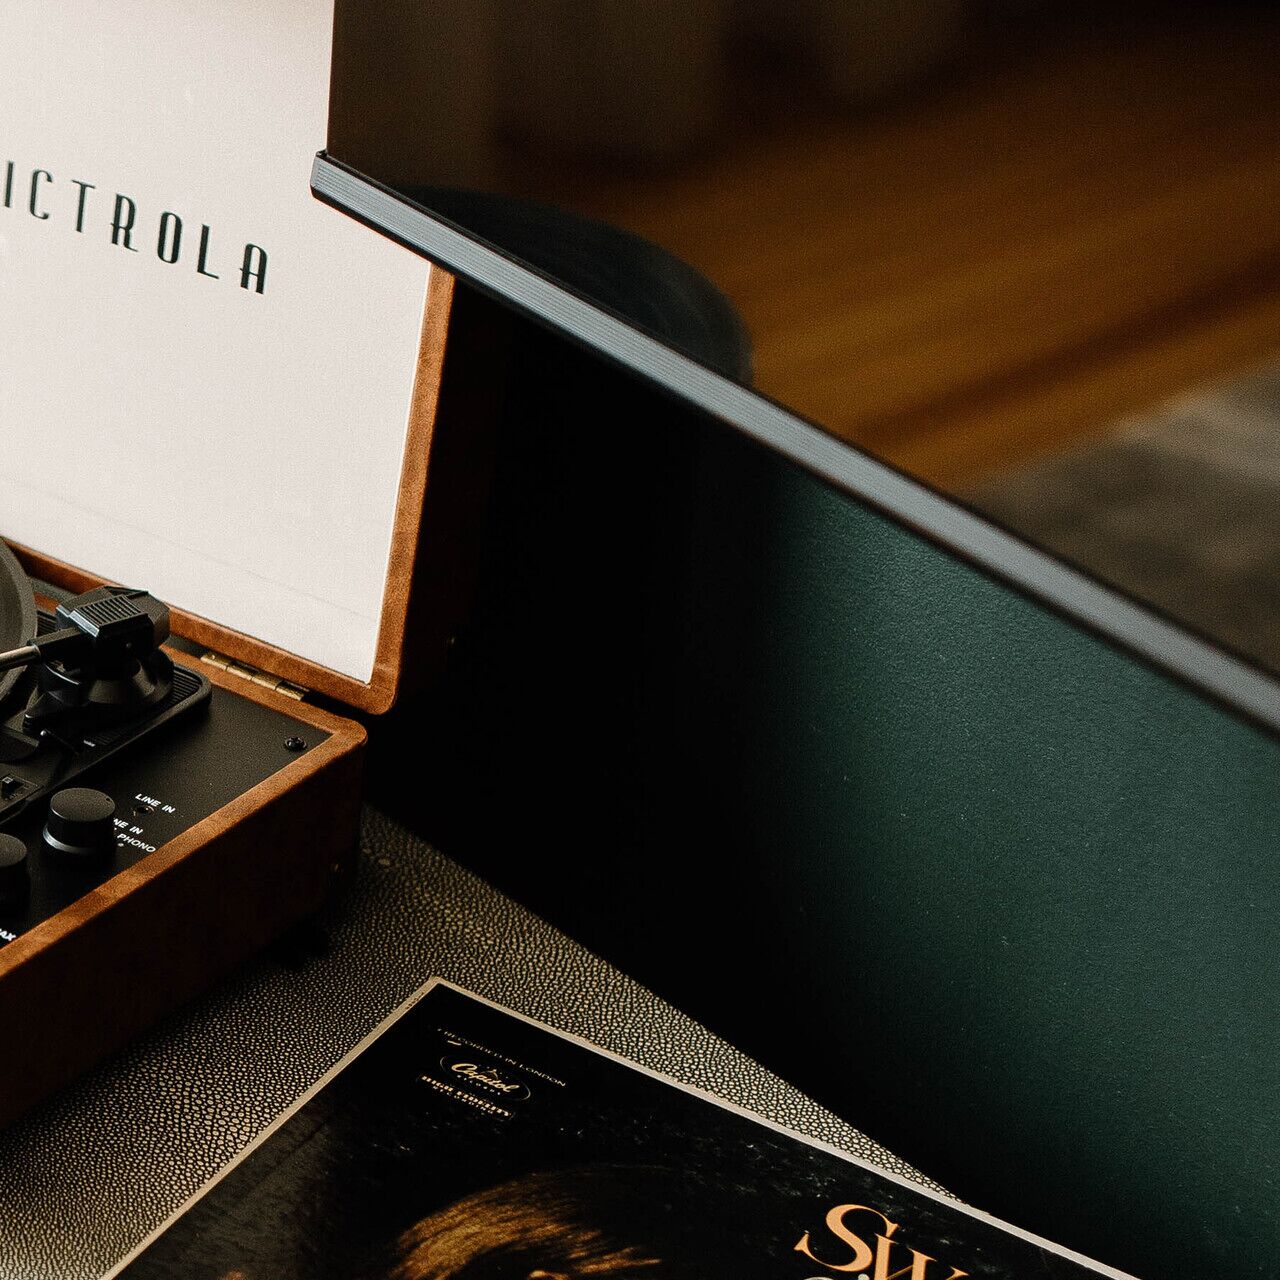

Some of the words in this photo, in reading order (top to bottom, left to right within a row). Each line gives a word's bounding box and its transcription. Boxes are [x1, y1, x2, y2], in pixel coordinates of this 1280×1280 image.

[135, 793, 161, 807] LINE
[161, 804, 176, 814] IN
[113, 818, 129, 829] NE
[129, 826, 144, 835] IN
[116, 833, 156, 853] PHONO
[451, 1062, 521, 1094] Capitol
[505, 1056, 518, 1066] IN
[518, 1063, 567, 1088] LONDON
